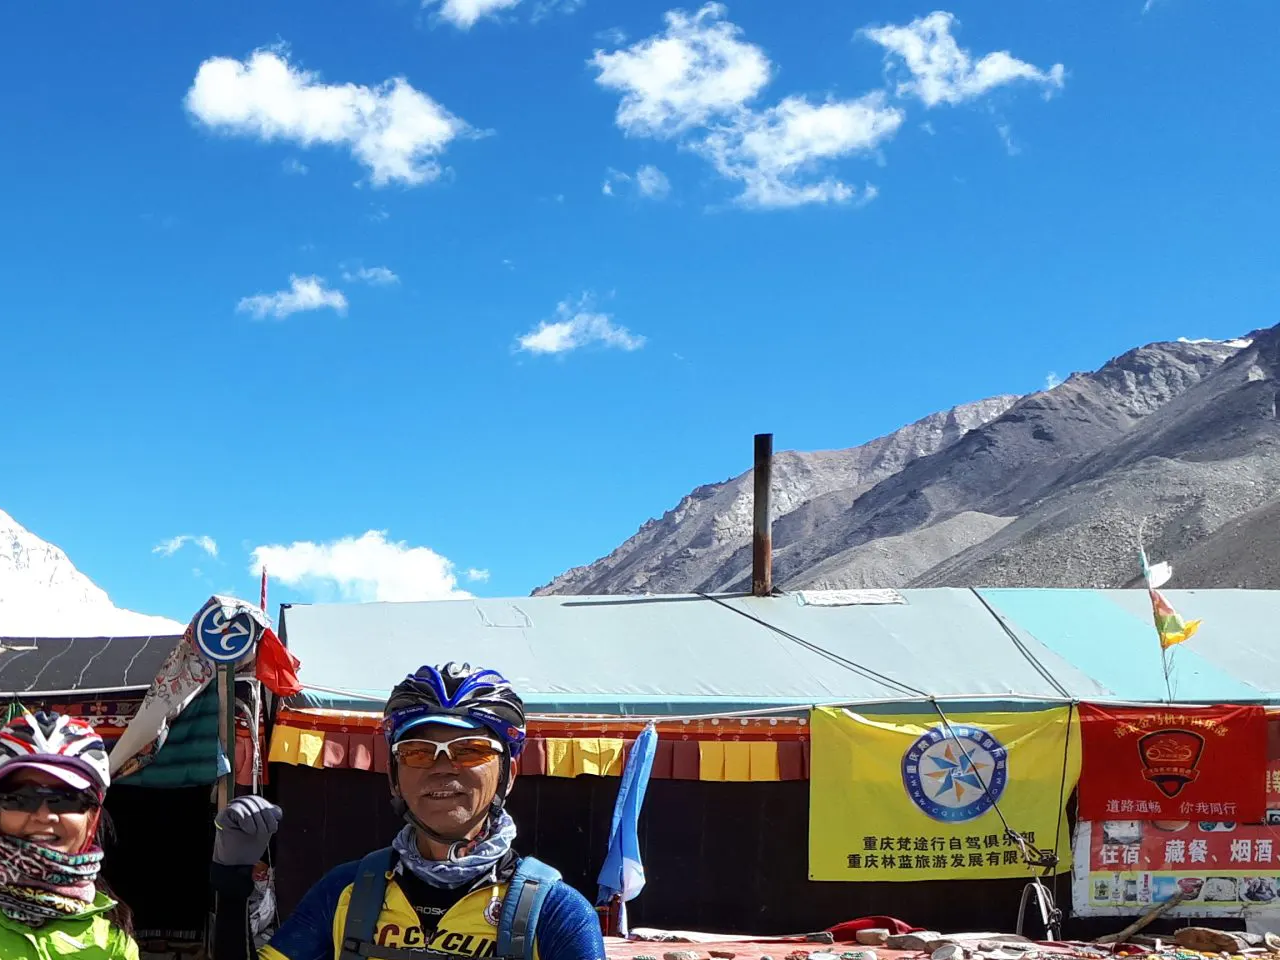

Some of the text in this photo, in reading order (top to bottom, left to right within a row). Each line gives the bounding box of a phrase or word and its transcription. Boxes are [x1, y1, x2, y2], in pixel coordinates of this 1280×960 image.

[1106, 799, 1237, 815] 道路通畅 你我同行
